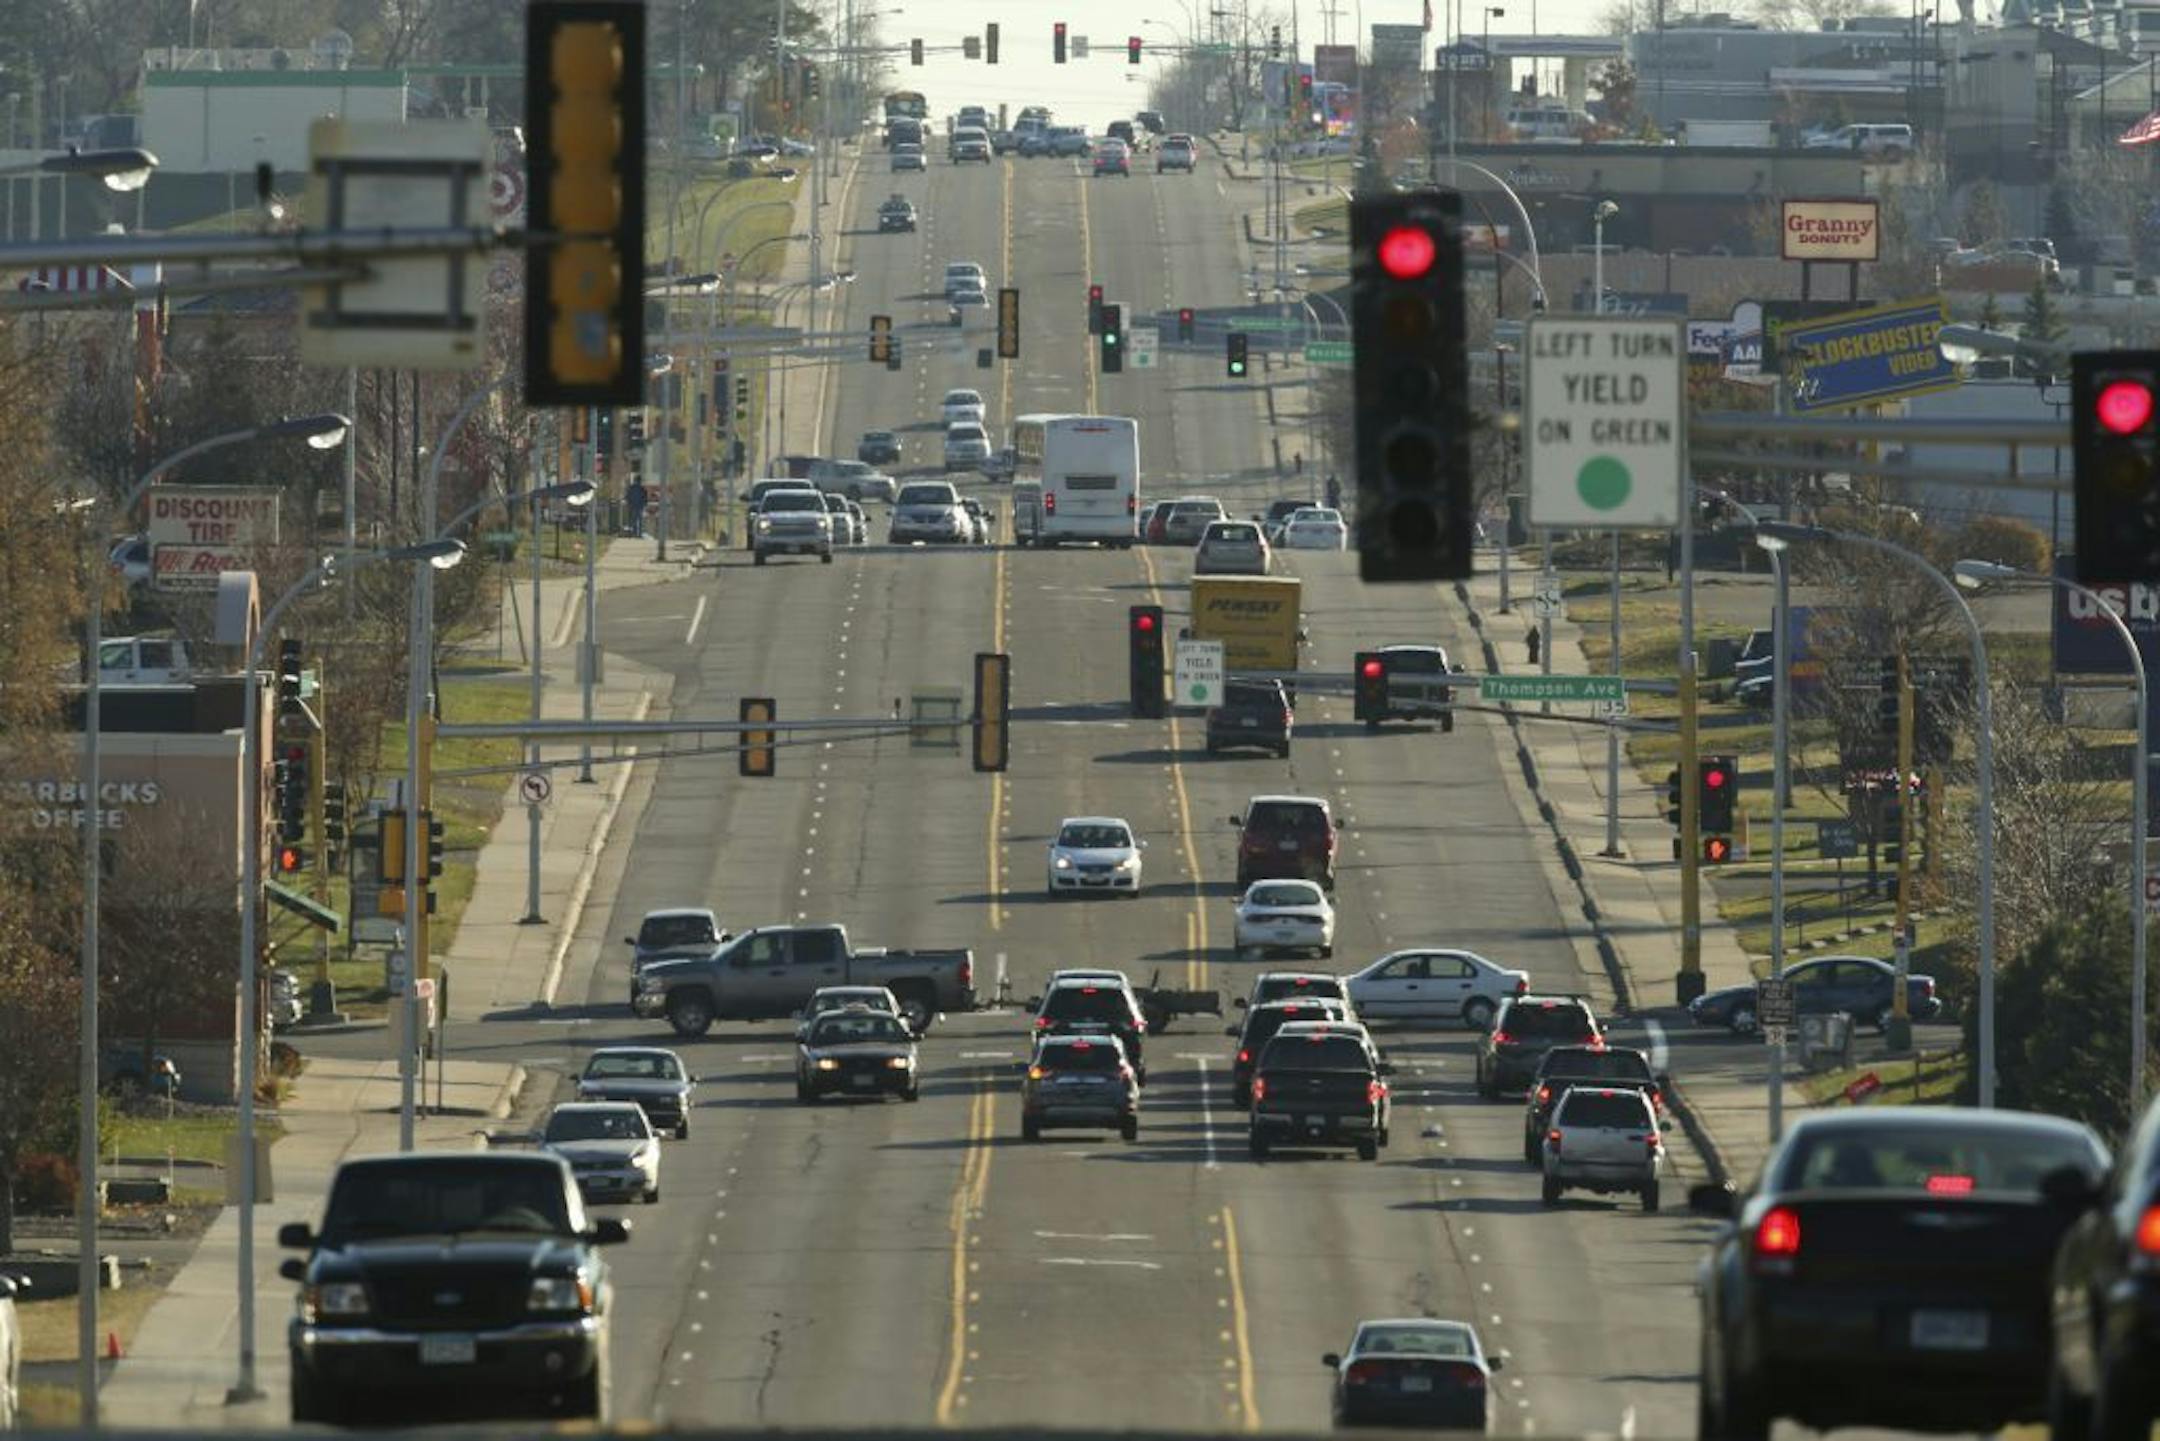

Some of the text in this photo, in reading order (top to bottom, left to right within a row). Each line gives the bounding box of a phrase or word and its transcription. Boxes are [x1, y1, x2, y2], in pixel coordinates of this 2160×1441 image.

[1788, 214, 1873, 236] Granny
[1799, 234, 1861, 244] DONUTS
[1534, 332, 1674, 358] LEFT TURN
[1888, 350, 1938, 377] VIDEO
[1562, 373, 1649, 405] YIELD
[1537, 418, 1671, 445] ON GREEN
[155, 498, 272, 519] DISCOUNT
[187, 522, 237, 542] TIRE
[1488, 681, 1616, 696] Thompson Ave
